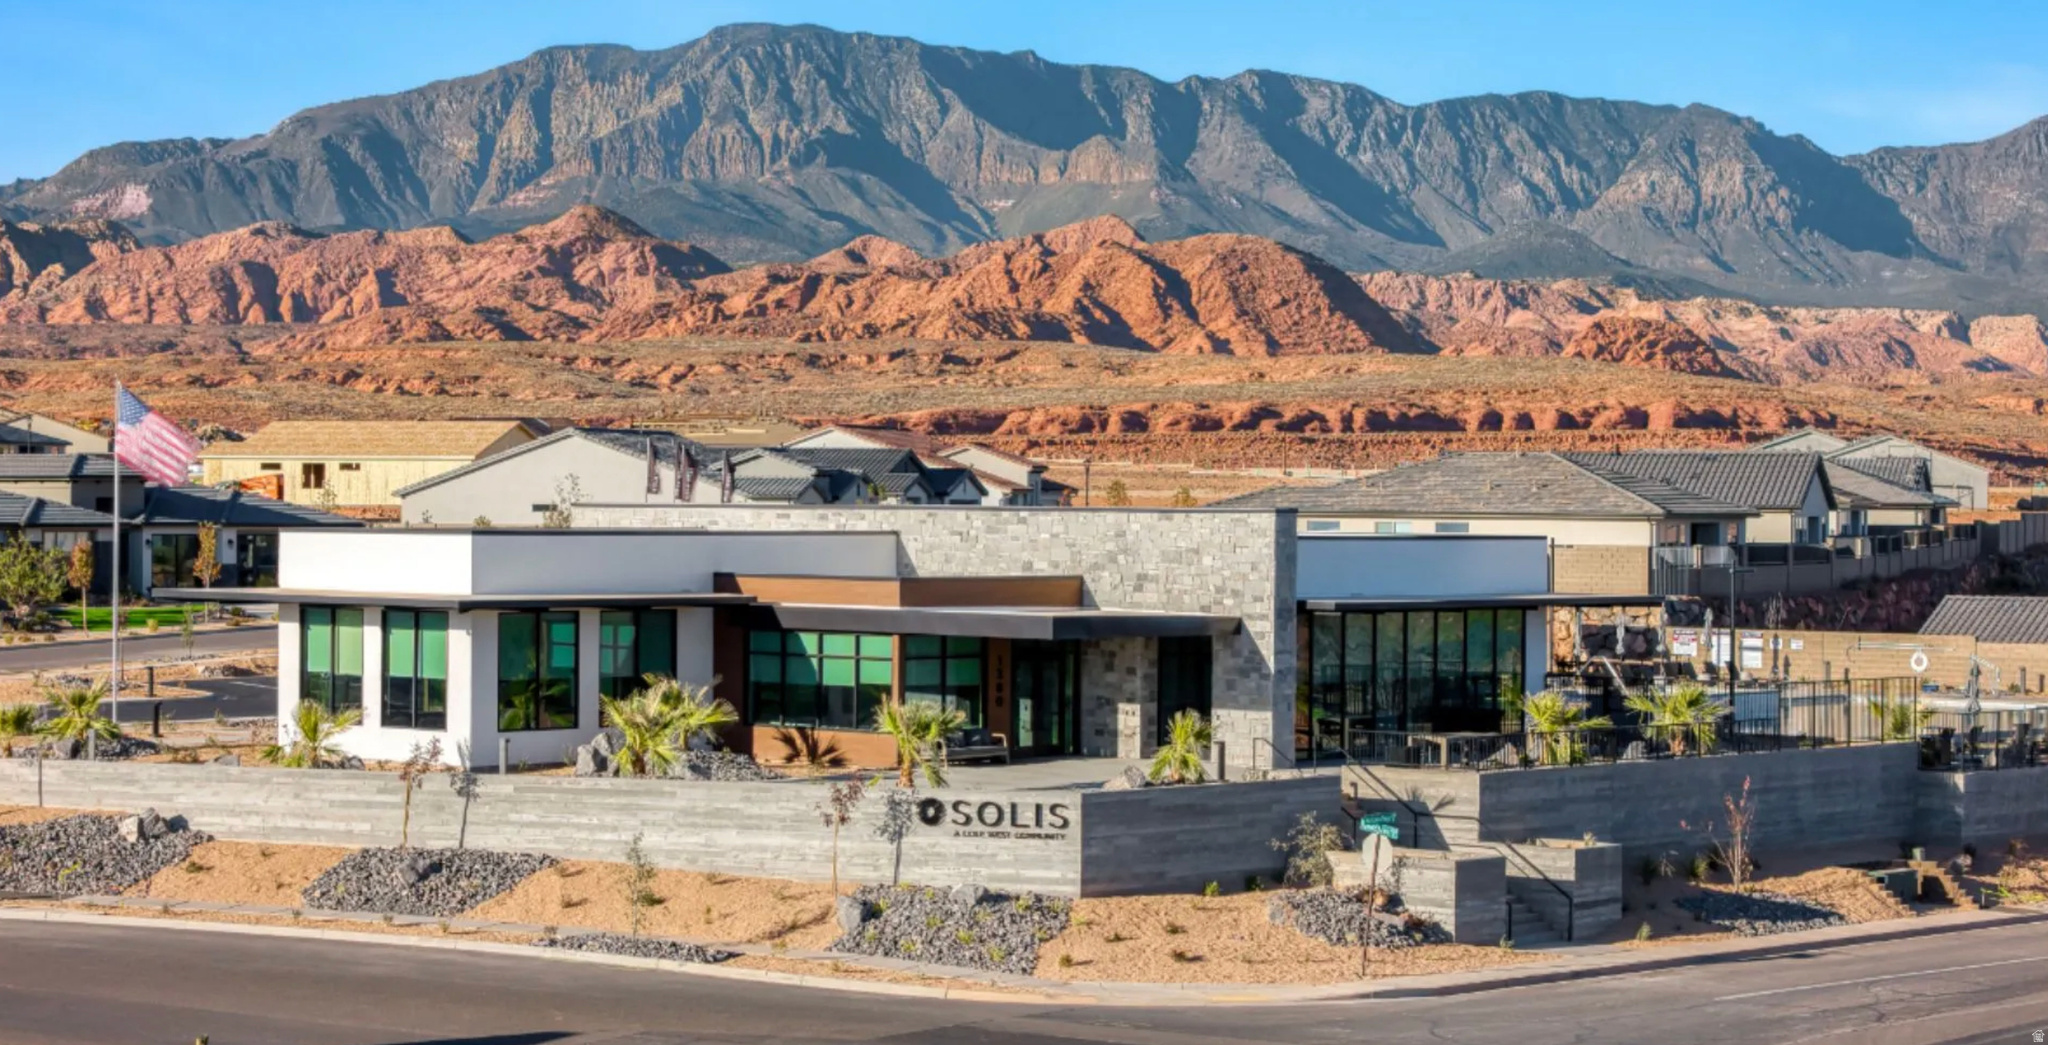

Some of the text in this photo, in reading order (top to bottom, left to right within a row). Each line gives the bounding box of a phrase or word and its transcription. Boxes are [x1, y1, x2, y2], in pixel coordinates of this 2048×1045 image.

[951, 800, 1070, 830] SOLIS
[987, 831, 1011, 839] WEST
[1014, 832, 1067, 840] COMMUNITY
